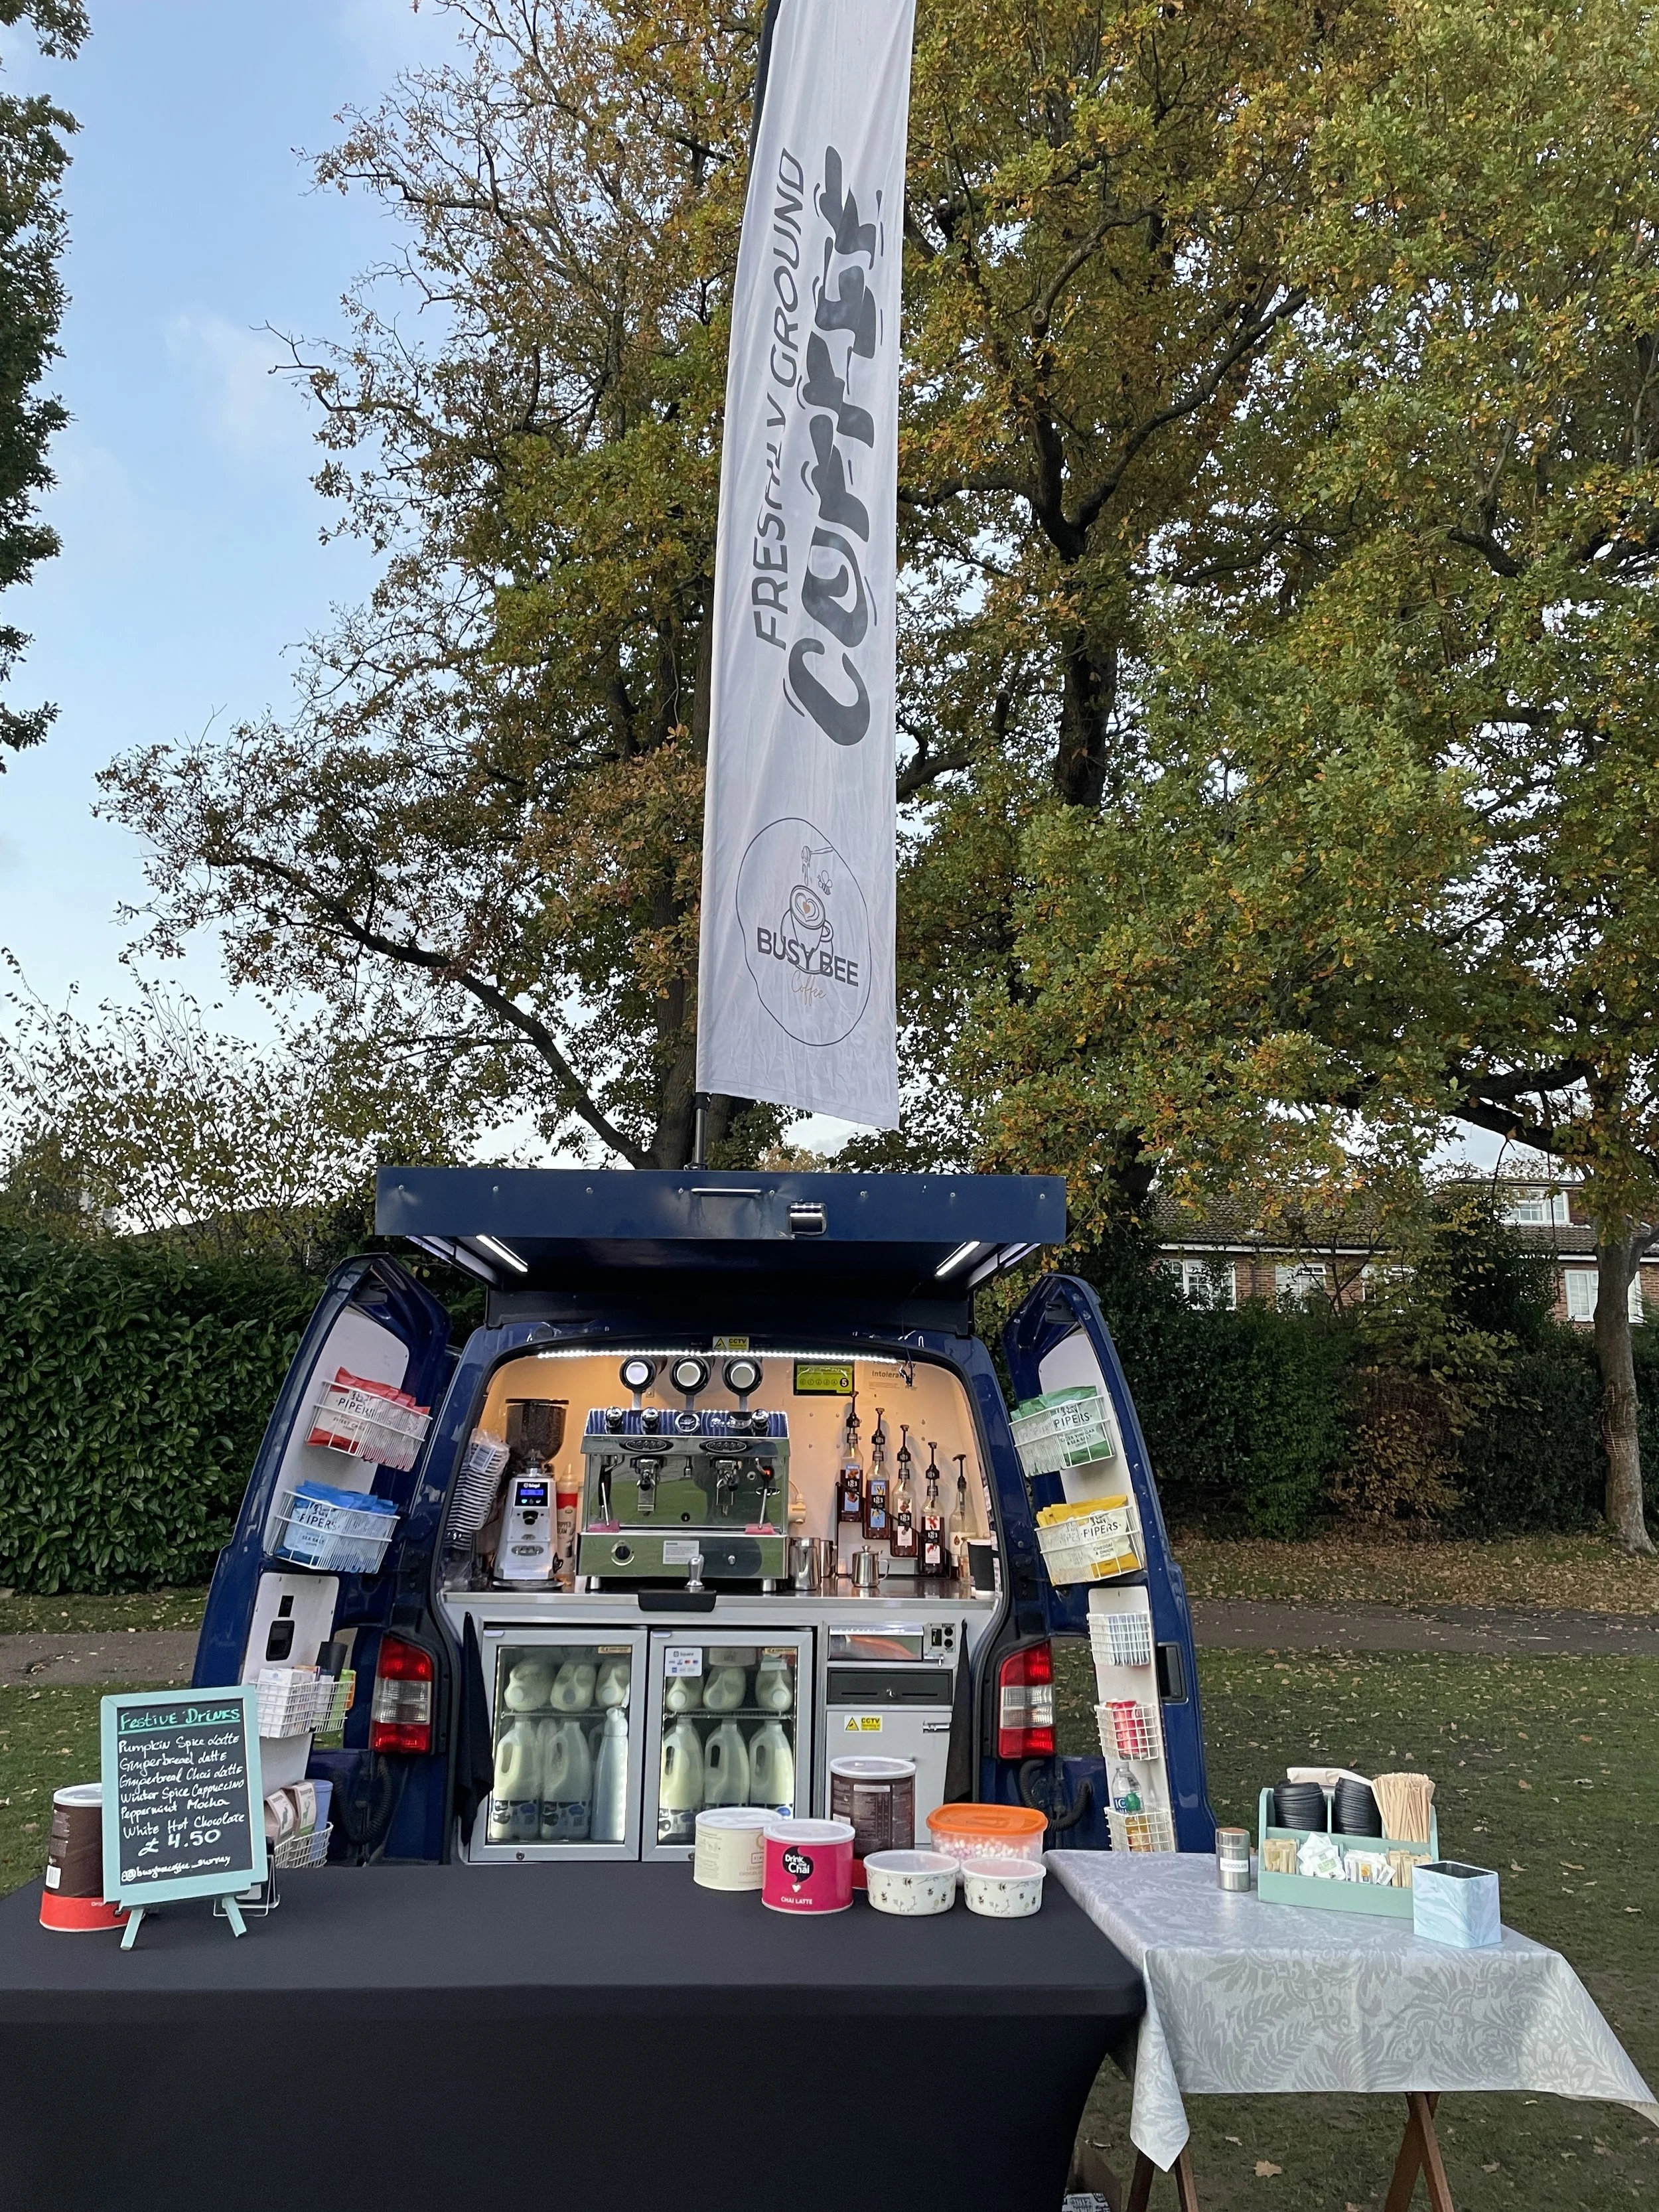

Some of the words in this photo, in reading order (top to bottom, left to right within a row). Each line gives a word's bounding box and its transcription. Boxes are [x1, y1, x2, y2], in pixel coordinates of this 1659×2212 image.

[769, 147, 805, 388] GROUND
[787, 145, 879, 747] COFFEE
[757, 927, 816, 970] BUSY
[820, 950, 859, 987] BEE
[791, 970, 826, 1006] Coffee
[1054, 1412, 1090, 1428] PIPERS
[162, 1788, 190, 1803] Spice
[121, 1801, 177, 1824] Peppermint
[187, 1798, 230, 1810] Mocha
[167, 1817, 188, 1834] Hot
[194, 1812, 245, 1828] Chocolate
[168, 1828, 222, 1848] 4.50
[785, 1854, 805, 1864] Drink
[788, 1862, 810, 1874] Chai
